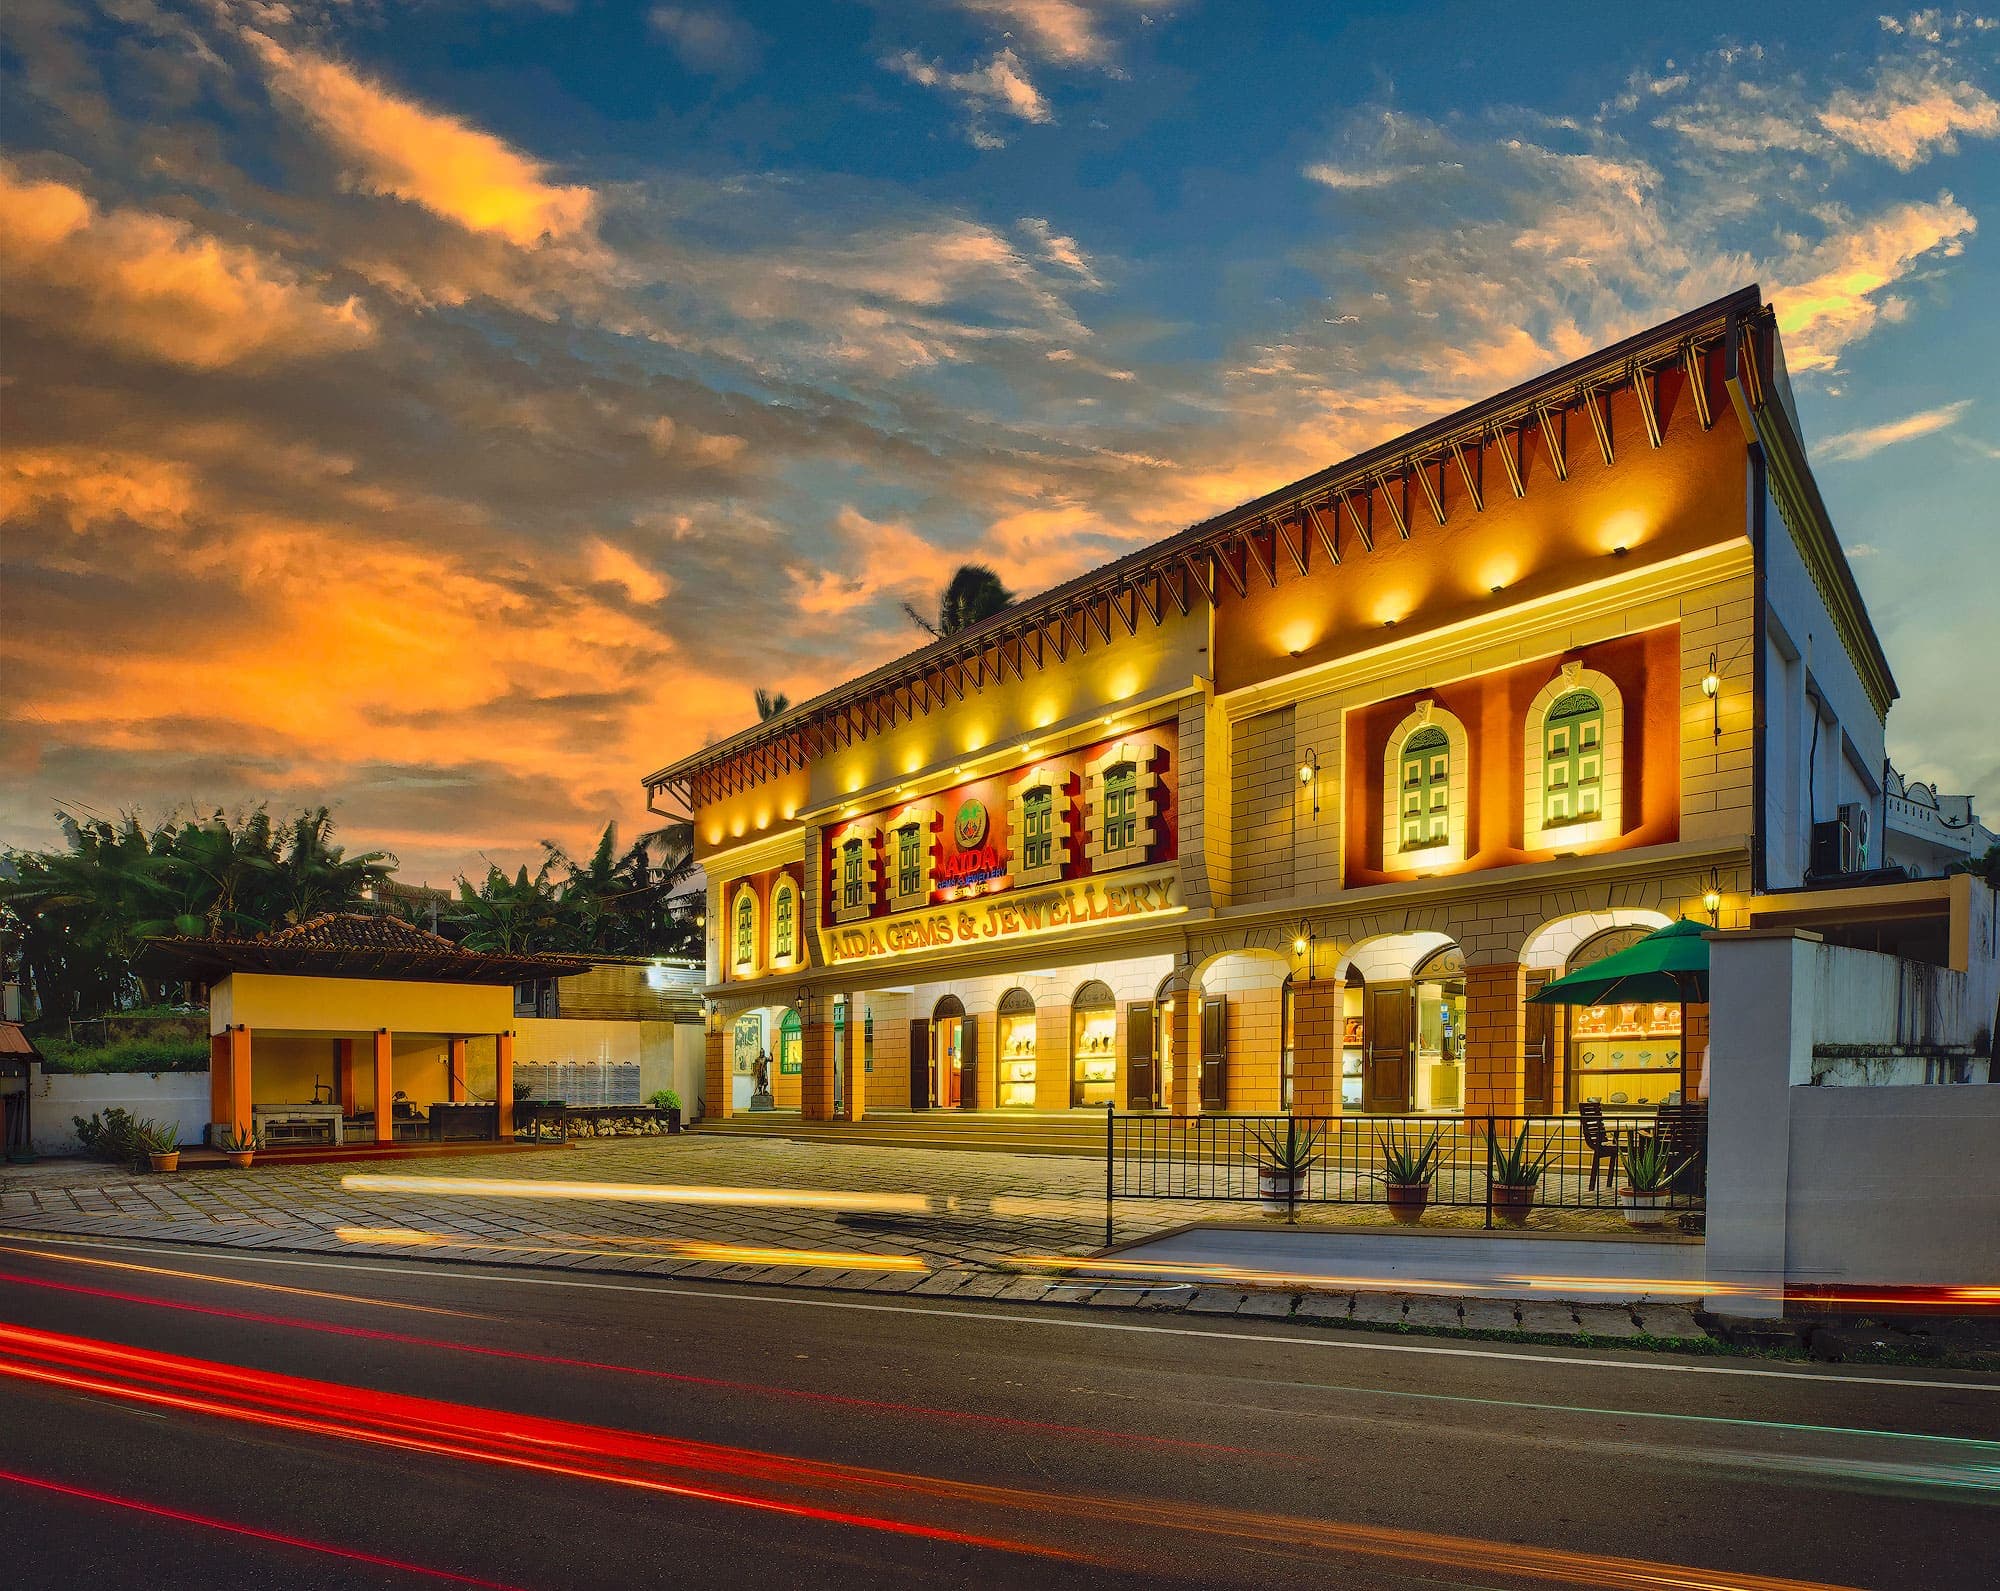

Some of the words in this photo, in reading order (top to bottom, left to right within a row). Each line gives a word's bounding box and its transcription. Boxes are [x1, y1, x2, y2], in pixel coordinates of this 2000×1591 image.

[945, 844, 996, 877] AIDA
[965, 867, 1006, 885] JEWELLERY
[831, 930, 886, 960] AIDA
[886, 918, 954, 951] GEMS
[957, 912, 979, 941] &
[983, 876, 1175, 937] JEWELLERY
